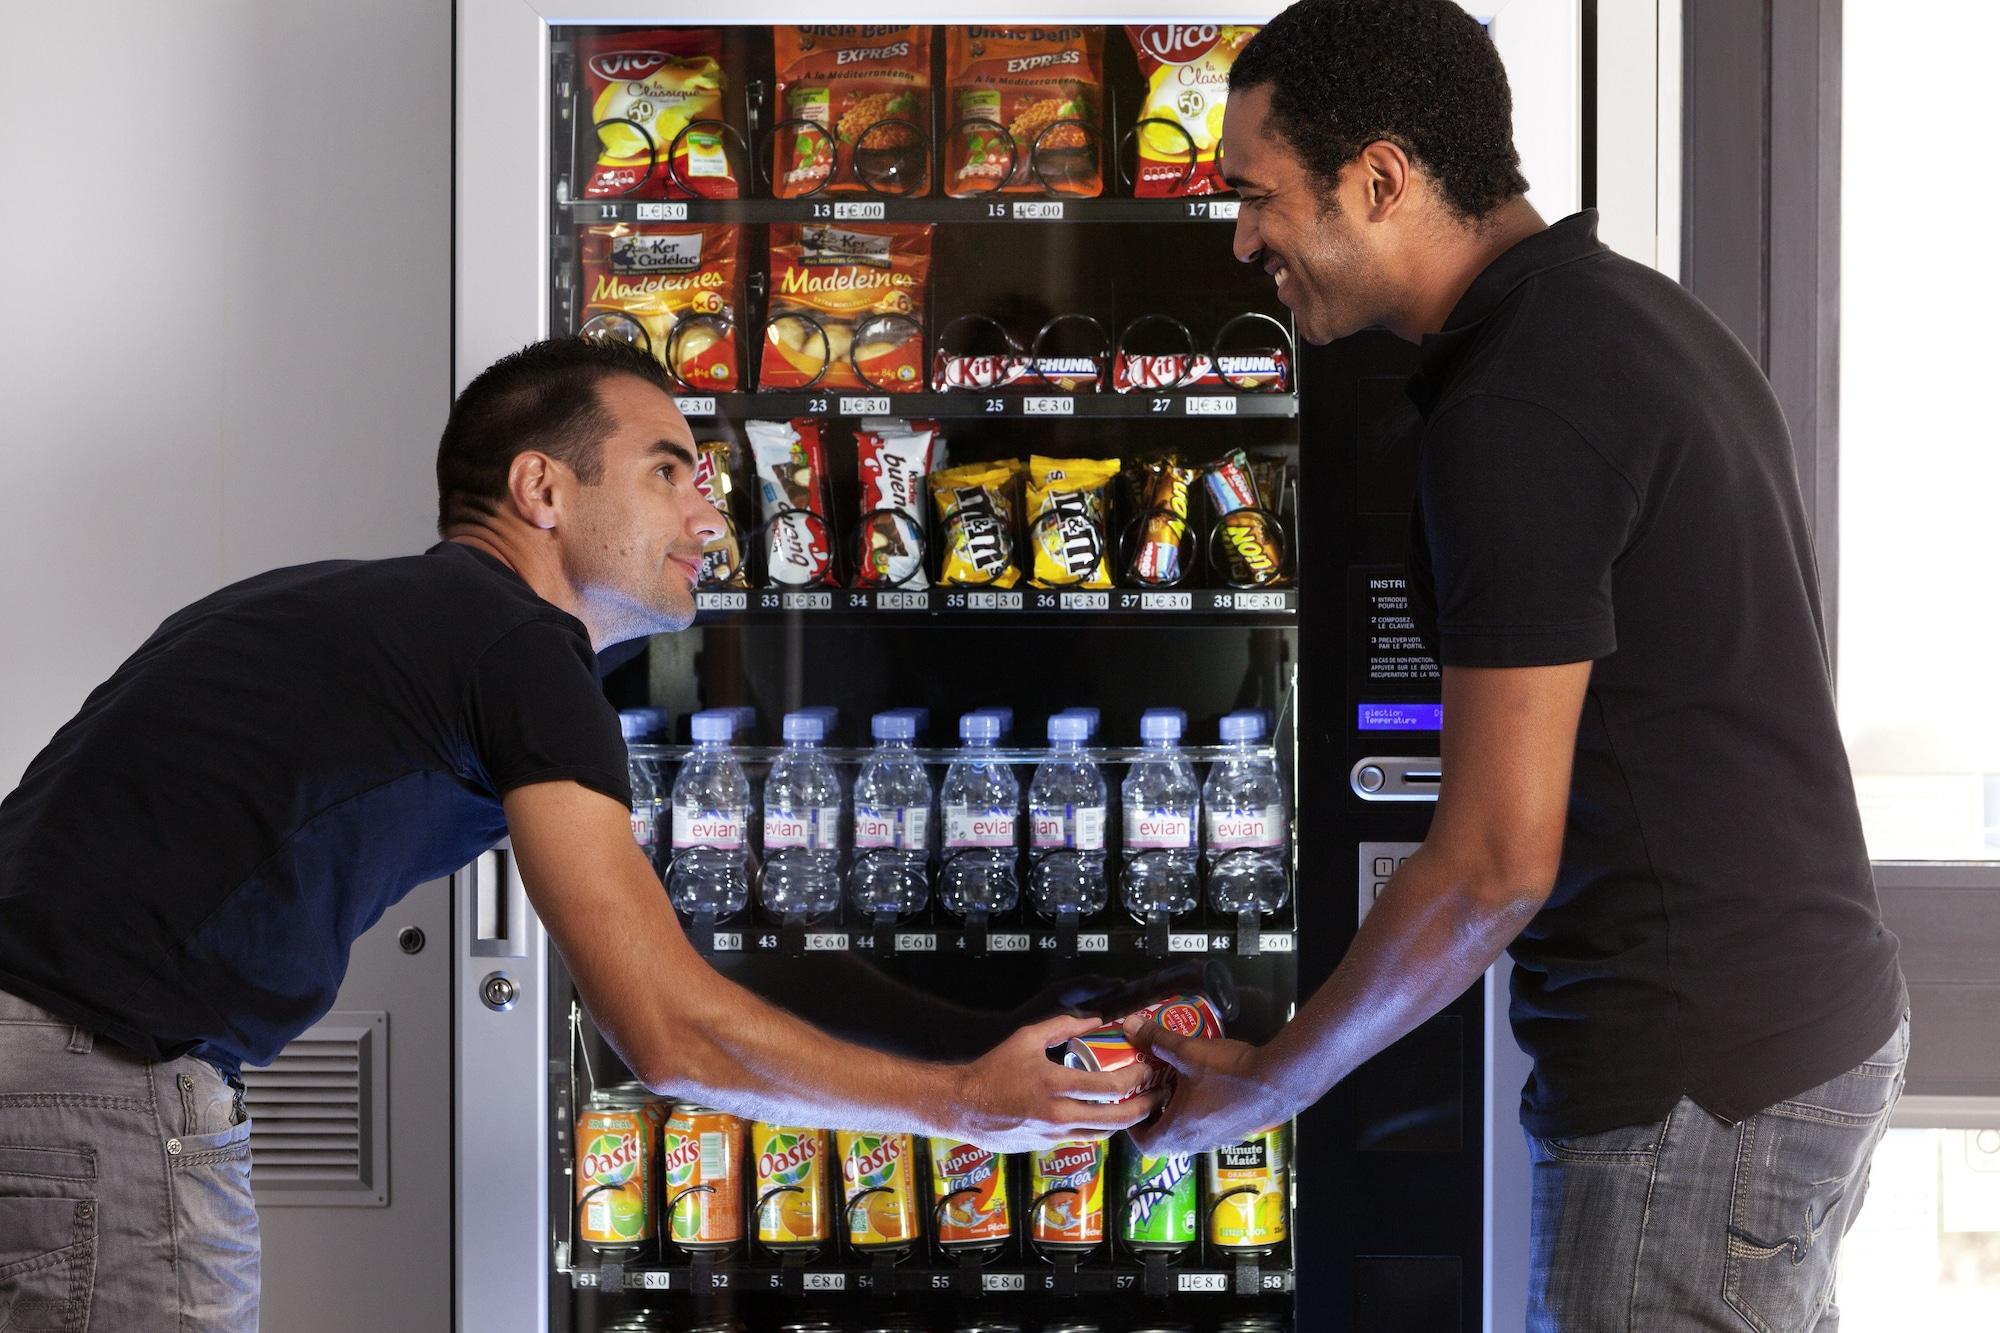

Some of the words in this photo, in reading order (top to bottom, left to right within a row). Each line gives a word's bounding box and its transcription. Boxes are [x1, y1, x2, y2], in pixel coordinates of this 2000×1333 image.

[836, 42, 909, 65] EXPRESS
[1007, 51, 1080, 73] EXPRESS
[1205, 61, 1215, 72] la
[601, 205, 618, 217] 11
[813, 204, 831, 217] 13
[988, 204, 1005, 216] 15
[1188, 203, 1206, 216] 17
[651, 238, 679, 253] Ker
[638, 253, 698, 267] Cadélac
[592, 271, 724, 302] Madeleines
[780, 266, 914, 294] Madeleines
[695, 294, 719, 312] x6
[809, 398, 827, 412] 23
[985, 398, 1003, 412] 25
[1152, 398, 1170, 412] 27
[761, 594, 779, 607] 33
[849, 594, 868, 607] 34
[946, 594, 965, 607] 35
[1036, 594, 1055, 607] 36
[1121, 594, 1139, 607] 37
[1214, 594, 1232, 607] 38
[1365, 716, 1417, 724] Temperature
[692, 821, 739, 838] evian
[766, 821, 803, 837] evian
[1140, 818, 1187, 837] evian
[1218, 818, 1265, 837] evian
[1382, 861, 1387, 873] 1
[758, 935, 777, 948] 43
[856, 935, 875, 948] 44
[1038, 936, 1057, 949] 46
[1211, 936, 1230, 949] 48
[758, 1133, 818, 1179] Oasis
[1220, 1144, 1263, 1155] Minute
[583, 1134, 638, 1181] Oasis
[843, 1134, 901, 1182] Oasis
[941, 1150, 989, 1173] Lipton
[1041, 1151, 1091, 1173] Lipton
[1225, 1153, 1258, 1166] Maid
[968, 1166, 991, 1183] Tea
[1069, 1169, 1092, 1187] Tea
[1127, 1150, 1191, 1226] Sprite
[580, 1273, 597, 1286] 51
[711, 1275, 728, 1287] 52
[932, 1276, 950, 1288] 55
[1116, 1276, 1134, 1288] 57
[1263, 1276, 1282, 1288] 58
